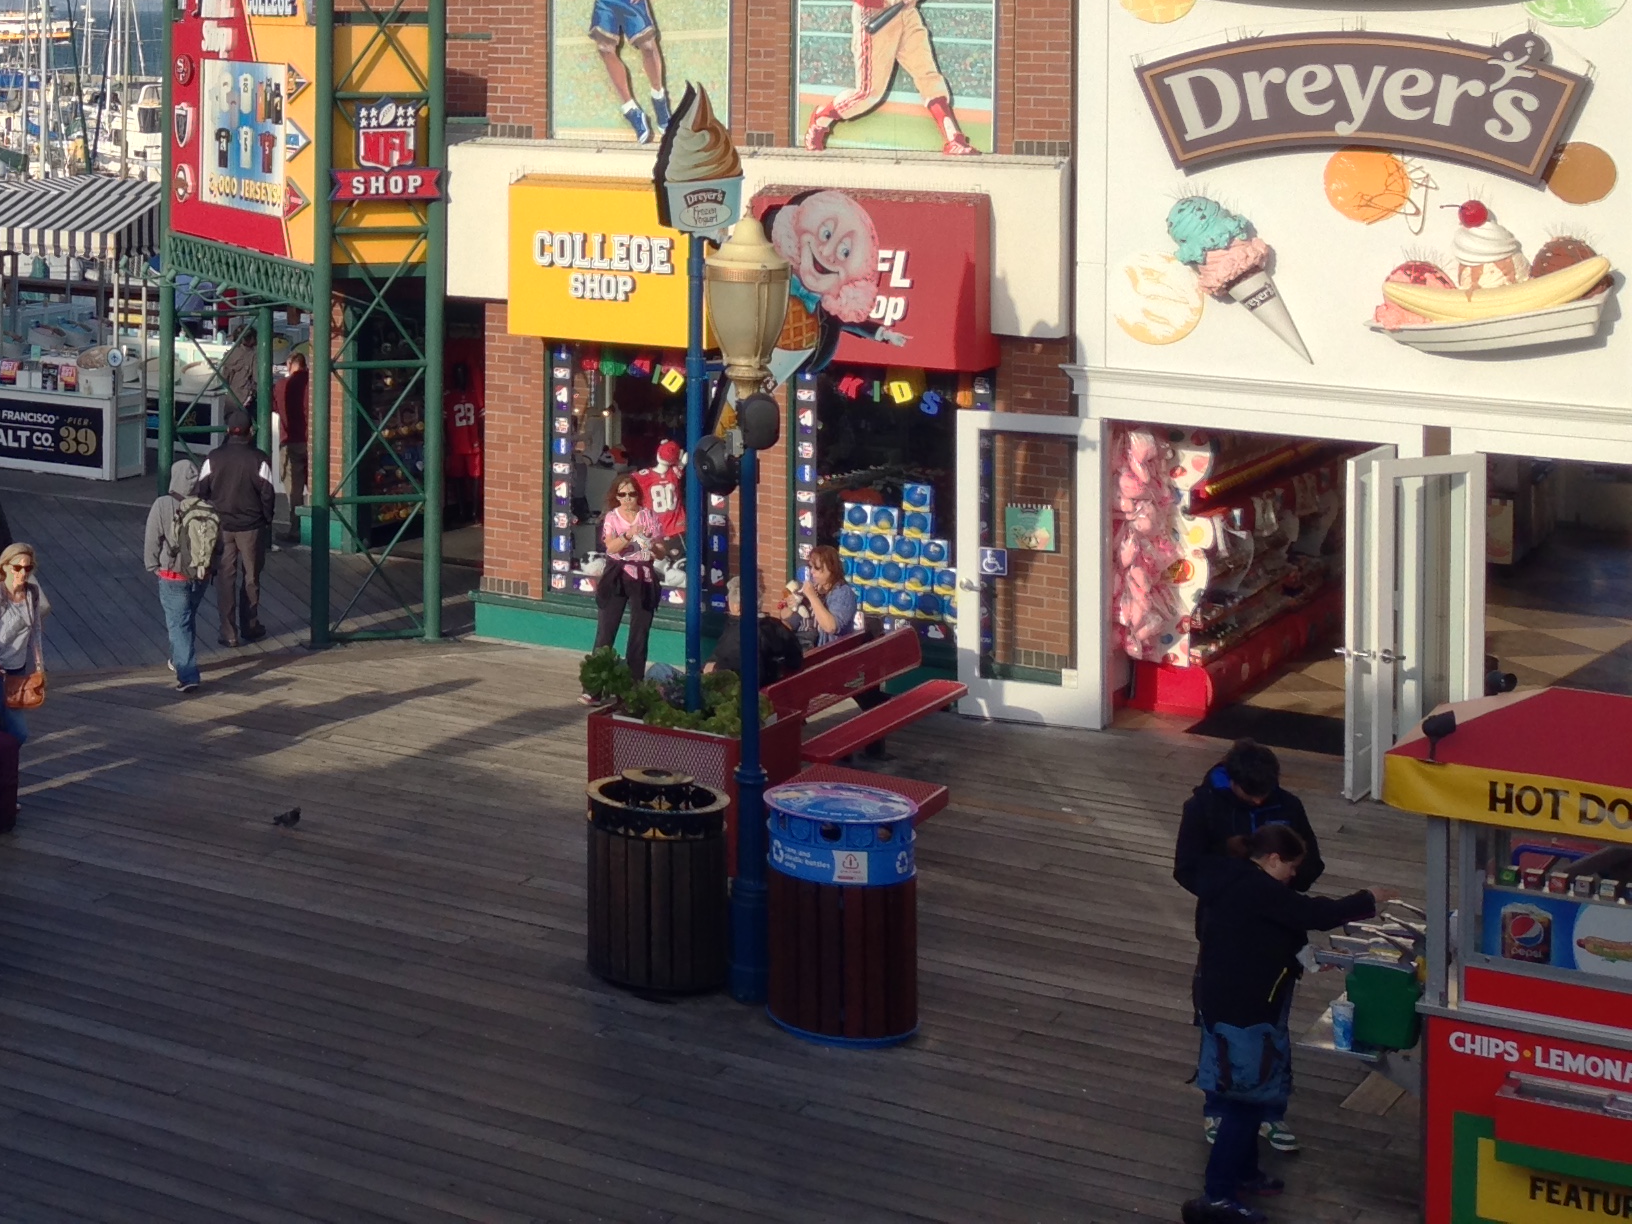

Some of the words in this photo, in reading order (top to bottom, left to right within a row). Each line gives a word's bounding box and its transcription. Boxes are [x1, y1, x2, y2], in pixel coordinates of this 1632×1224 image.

[1163, 56, 1540, 144] Dreyer's
[361, 130, 414, 169] NFL
[352, 175, 422, 195] SHOP
[533, 230, 675, 275] COLLEGE
[877, 249, 914, 289] FL
[569, 271, 636, 302] SHOP
[838, 374, 943, 416] KIDS
[1, 410, 56, 426] FRANCISCO
[66, 416, 90, 426] PIER
[31, 432, 55, 448] CO.
[58, 424, 98, 457] 39
[650, 483, 678, 514] 80
[1488, 780, 1570, 821] HOT
[1448, 1031, 1520, 1063] CHIPS
